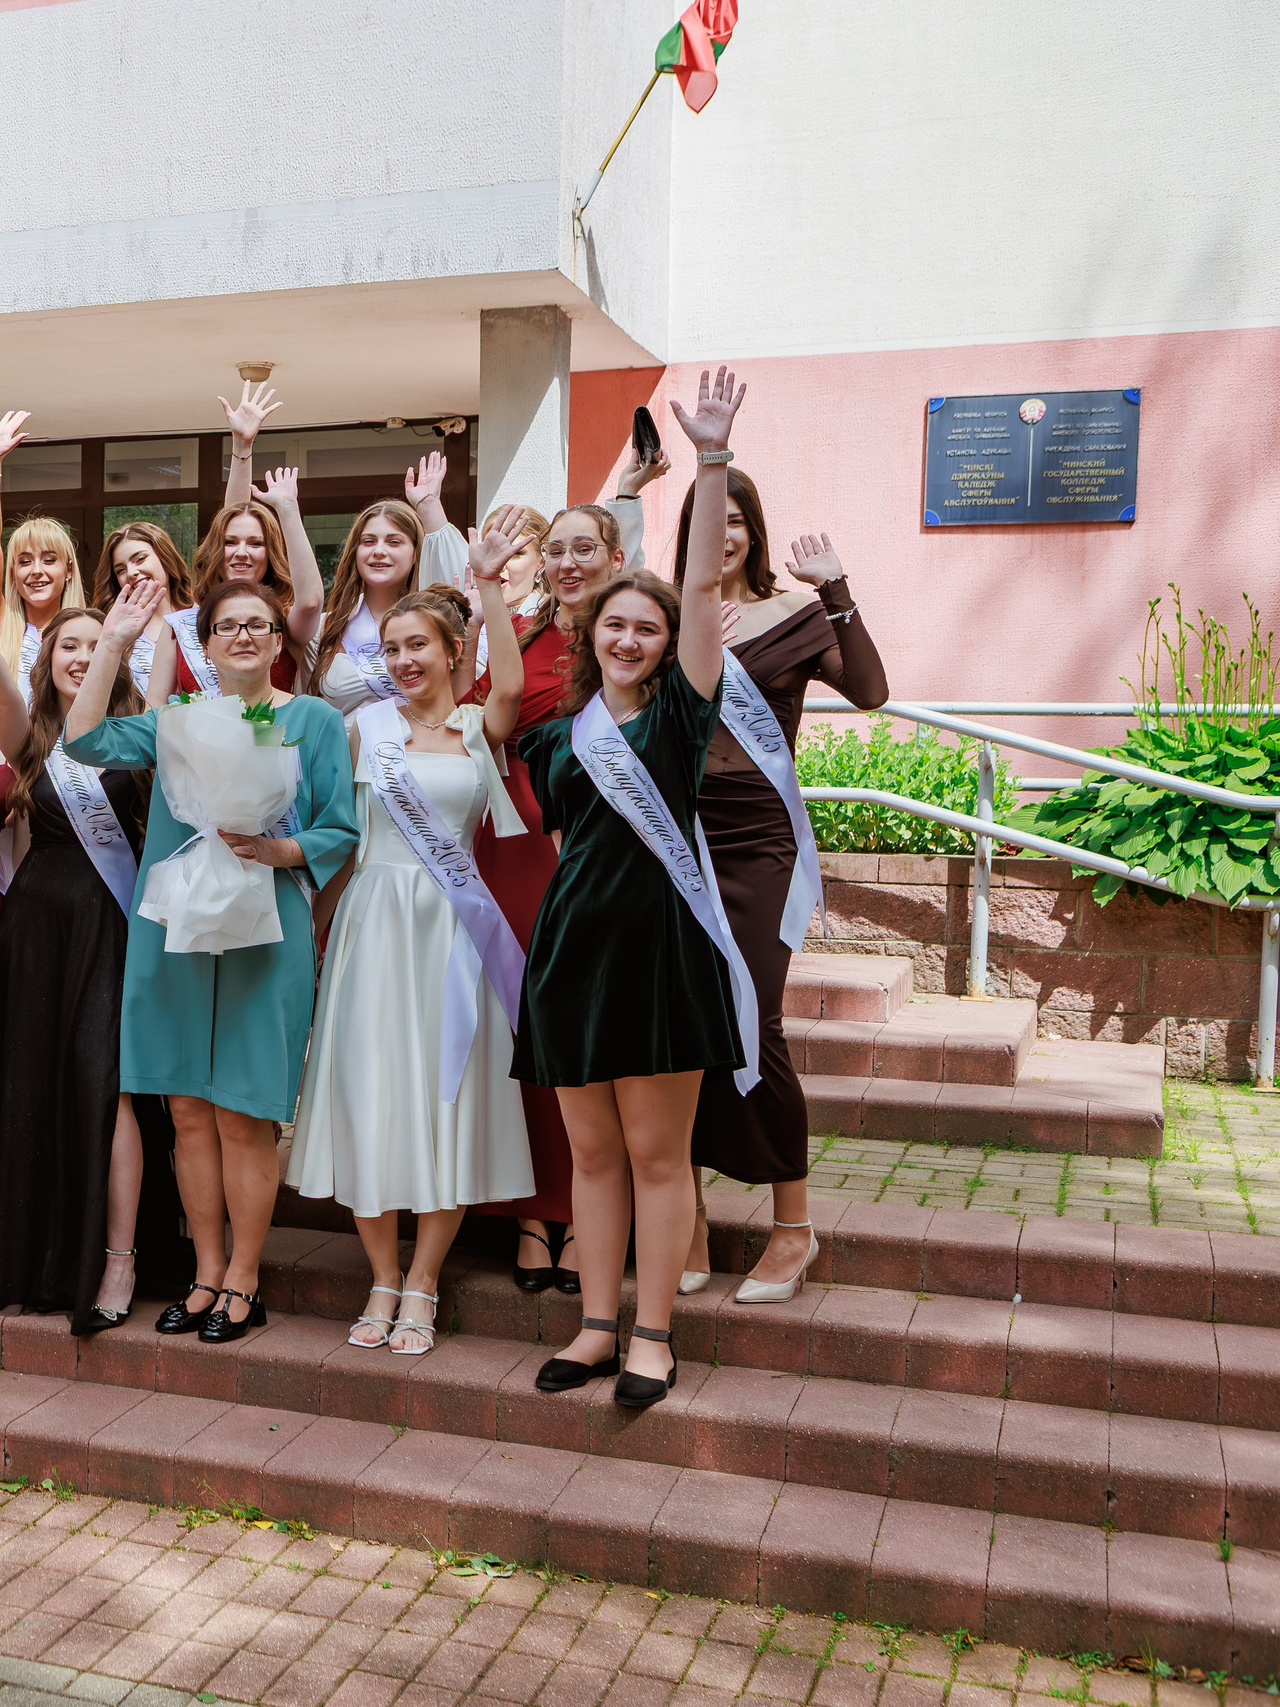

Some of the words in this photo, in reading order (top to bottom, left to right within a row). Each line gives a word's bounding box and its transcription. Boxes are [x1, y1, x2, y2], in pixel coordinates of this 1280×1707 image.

[957, 481, 996, 489] КАЛЕДЖ
[1043, 467, 1125, 477] ГОСУДАРСТВЕННЫЙ
[1060, 478, 1106, 486] КОЛЛЕДЖ
[961, 489, 992, 497] СФЕРЫ
[737, 704, 788, 754] 2025
[588, 737, 670, 846] Выпускница
[79, 800, 124, 845] 2025
[373, 741, 440, 845] Выпускница
[427, 838, 480, 889] 2025
